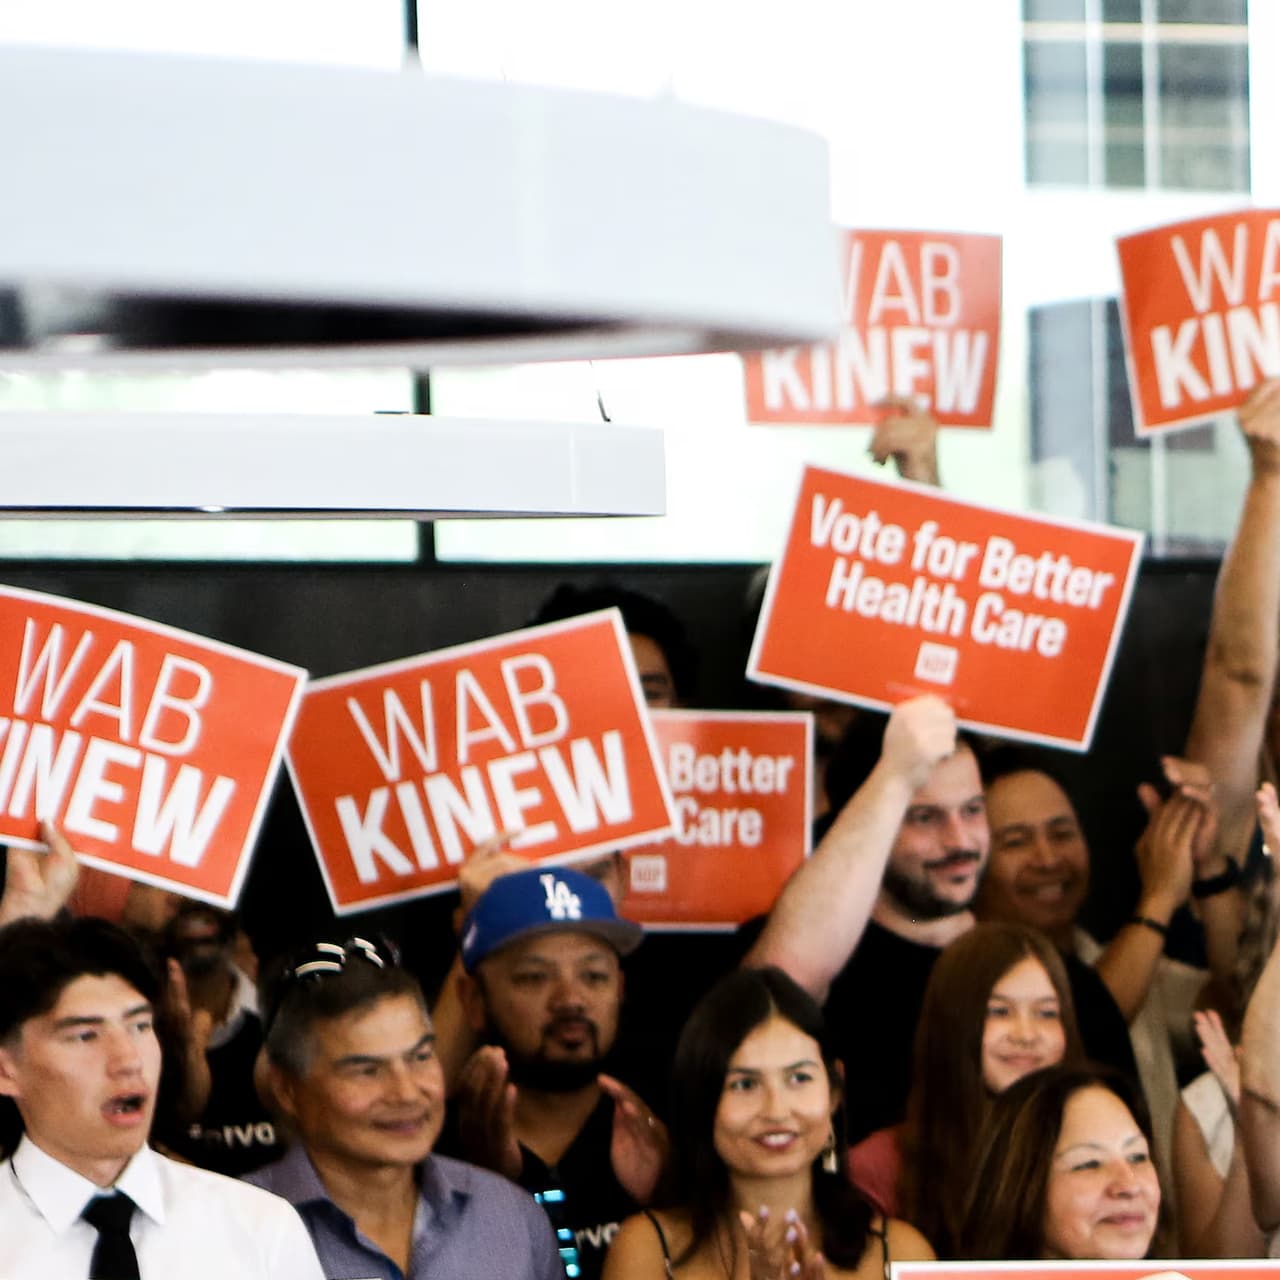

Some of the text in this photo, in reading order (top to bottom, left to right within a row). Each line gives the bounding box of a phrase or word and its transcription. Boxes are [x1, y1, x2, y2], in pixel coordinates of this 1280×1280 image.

[762, 325, 989, 413] KINEW
[809, 494, 1114, 611] Vote for Better
[825, 564, 1067, 657] Health Care
[14, 616, 213, 757] WAB
[347, 653, 571, 782] WAB
[335, 731, 636, 885] KINEW
[669, 742, 794, 794] Better
[674, 795, 764, 847] Care
[539, 873, 582, 921] LA
